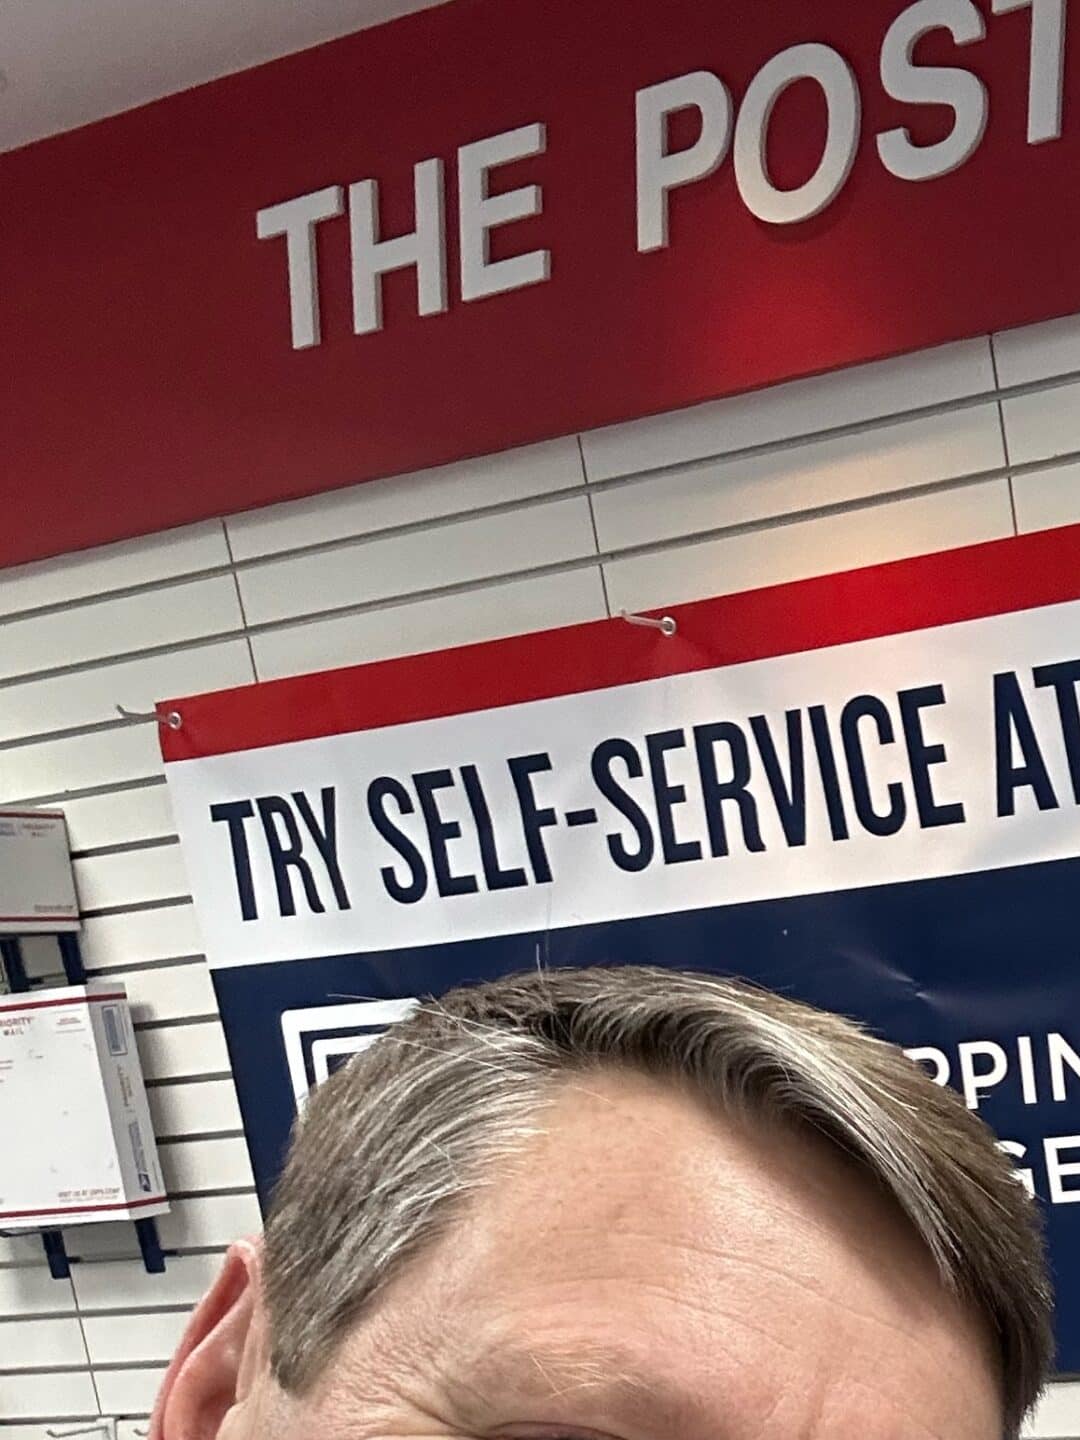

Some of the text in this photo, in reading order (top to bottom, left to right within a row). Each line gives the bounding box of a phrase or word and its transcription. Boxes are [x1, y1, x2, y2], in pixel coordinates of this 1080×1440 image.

[257, 123, 549, 349] THE
[210, 787, 350, 921] TRY
[367, 684, 965, 904] SELF-SERVICE
